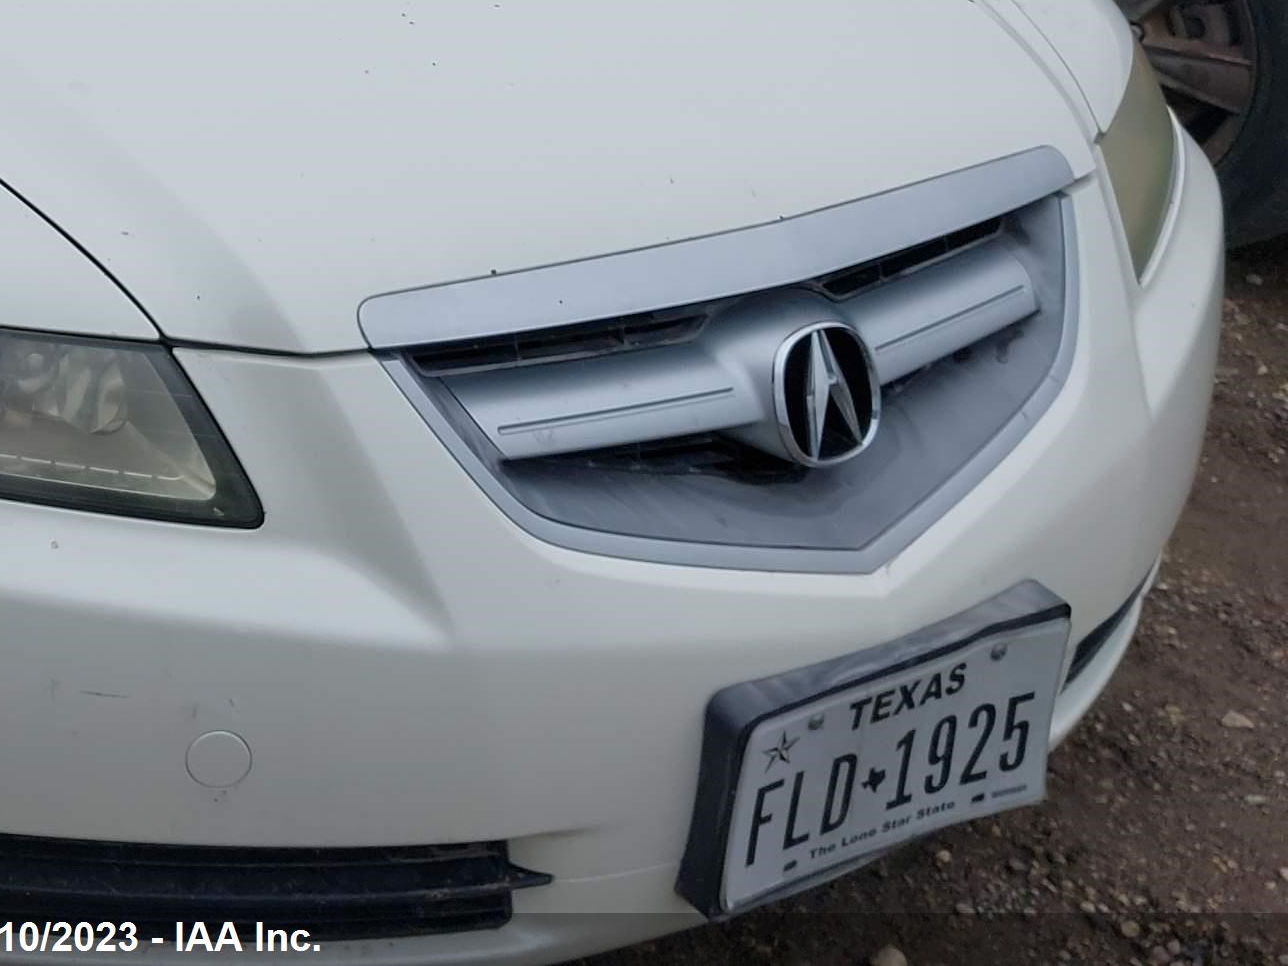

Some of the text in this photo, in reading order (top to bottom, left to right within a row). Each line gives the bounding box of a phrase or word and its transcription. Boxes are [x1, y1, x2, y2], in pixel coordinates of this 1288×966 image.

[849, 662, 967, 731] TEXAS
[745, 690, 1035, 868] FLD 1925
[809, 800, 955, 860] The Lone Star State
